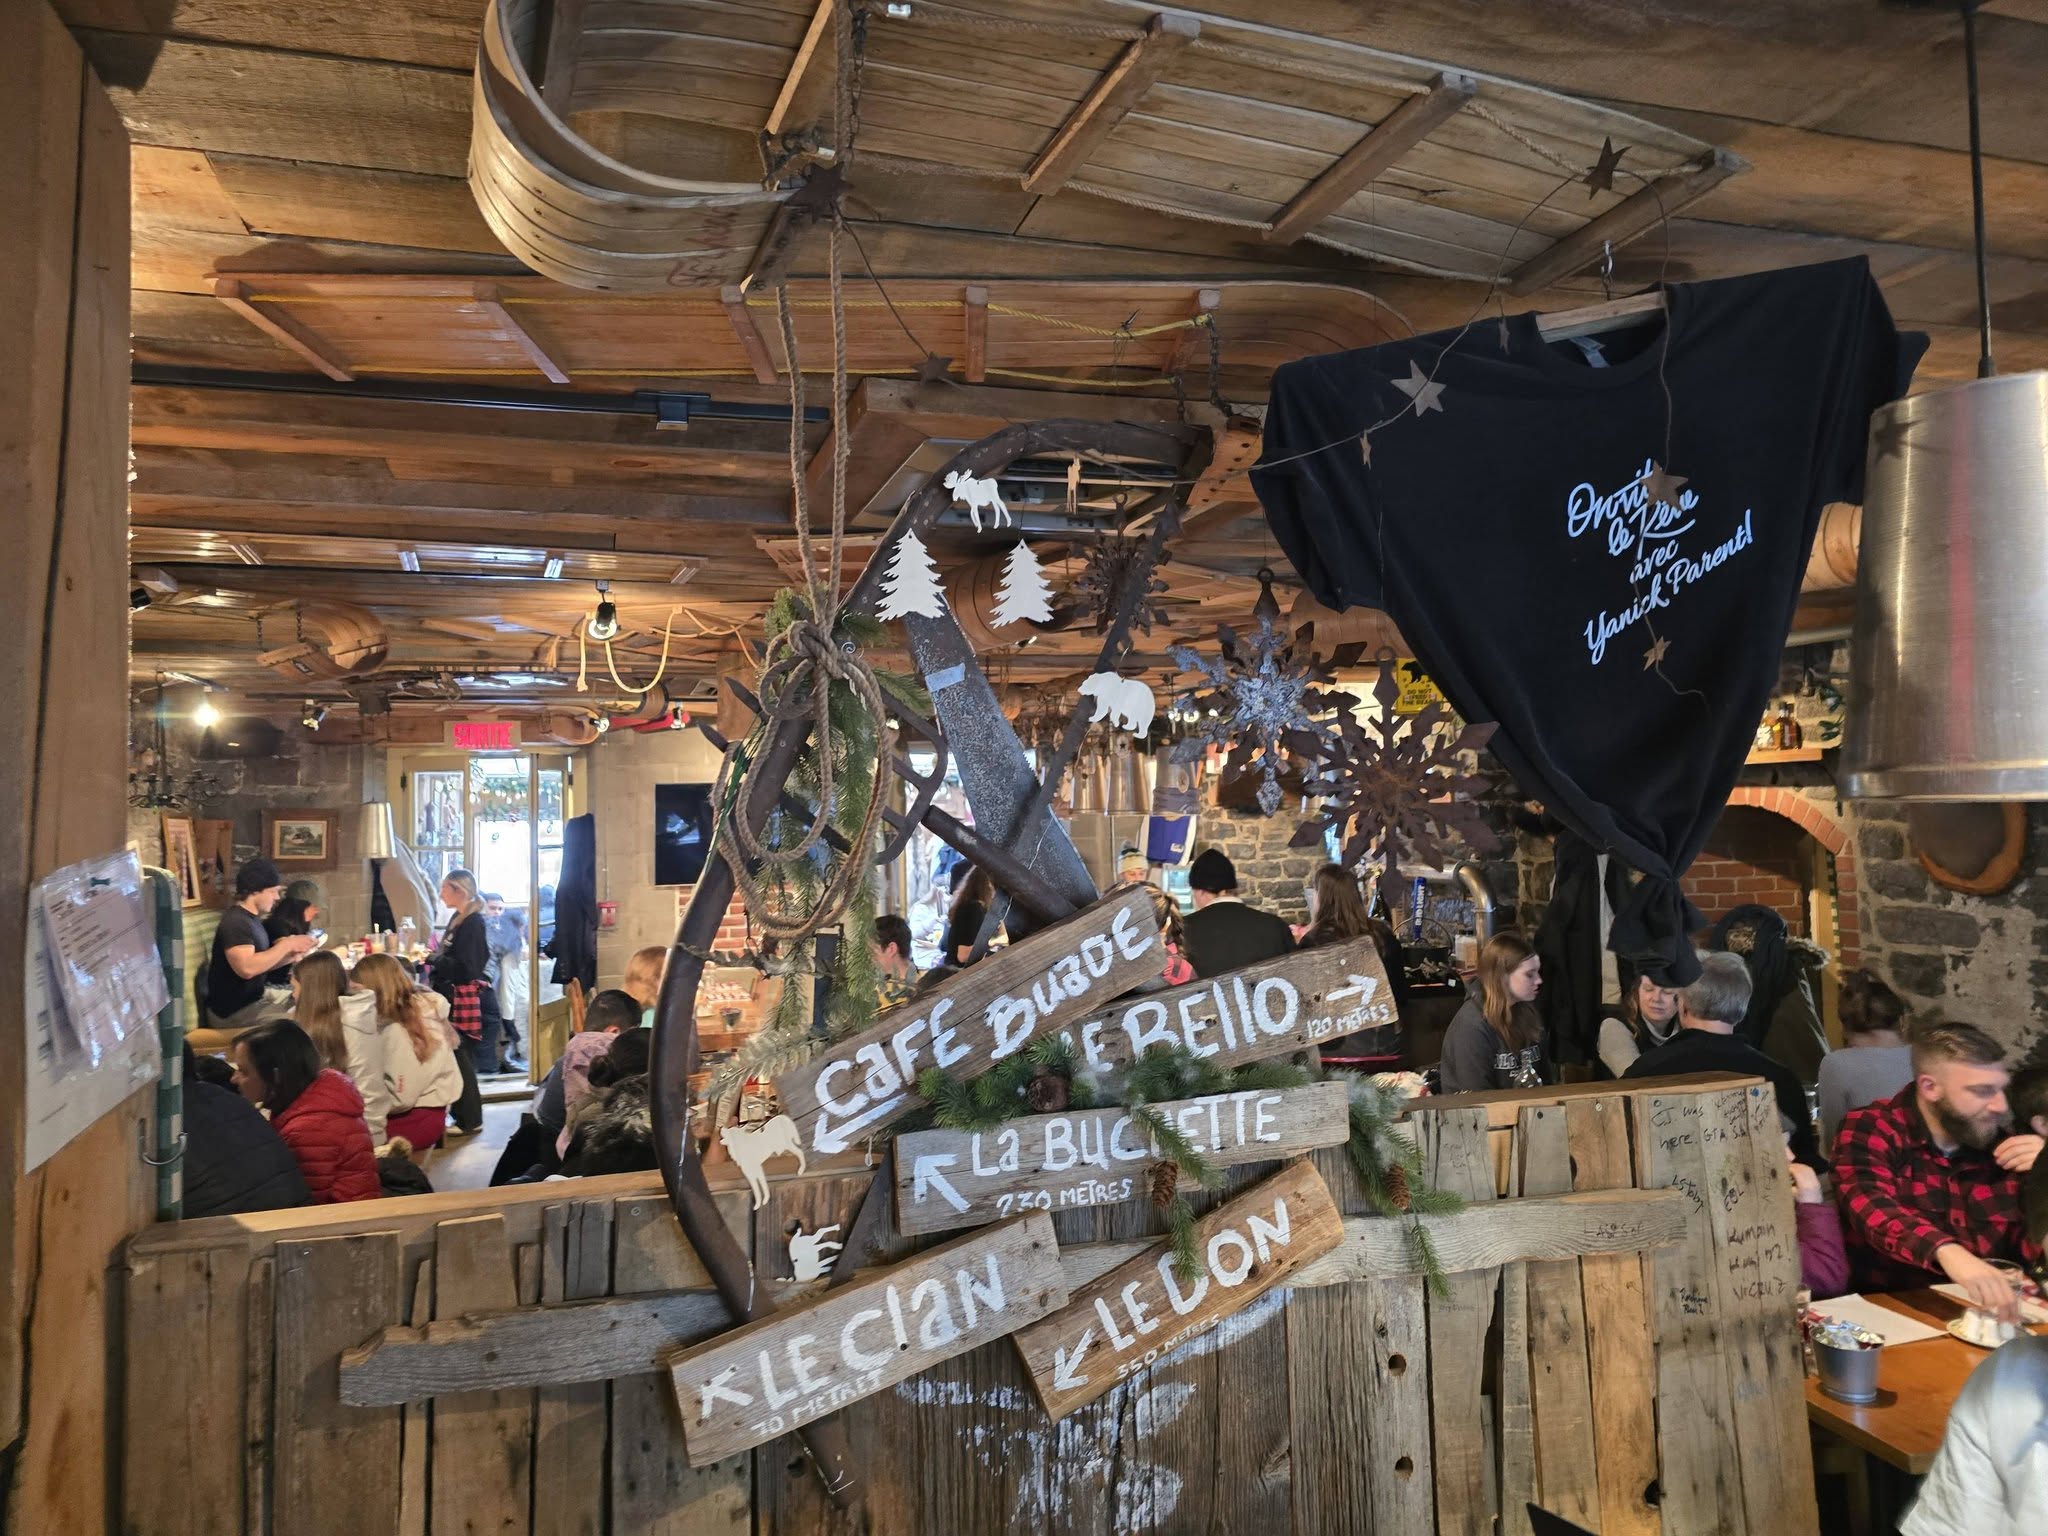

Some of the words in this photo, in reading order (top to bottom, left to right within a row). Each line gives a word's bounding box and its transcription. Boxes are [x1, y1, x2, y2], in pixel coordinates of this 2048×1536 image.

[1608, 517, 1635, 556] le
[1629, 540, 1679, 584] avec
[1583, 573, 1670, 665] Yanick
[453, 723, 513, 748] SORTIE
[1306, 1015, 1332, 1039] 120
[1041, 1090, 1283, 1172] BUCETTE
[1060, 1178, 1133, 1206] METRES
[1094, 1280, 1161, 1352] LE
[1157, 1197, 1290, 1315] DON
[758, 1334, 832, 1411] LE
